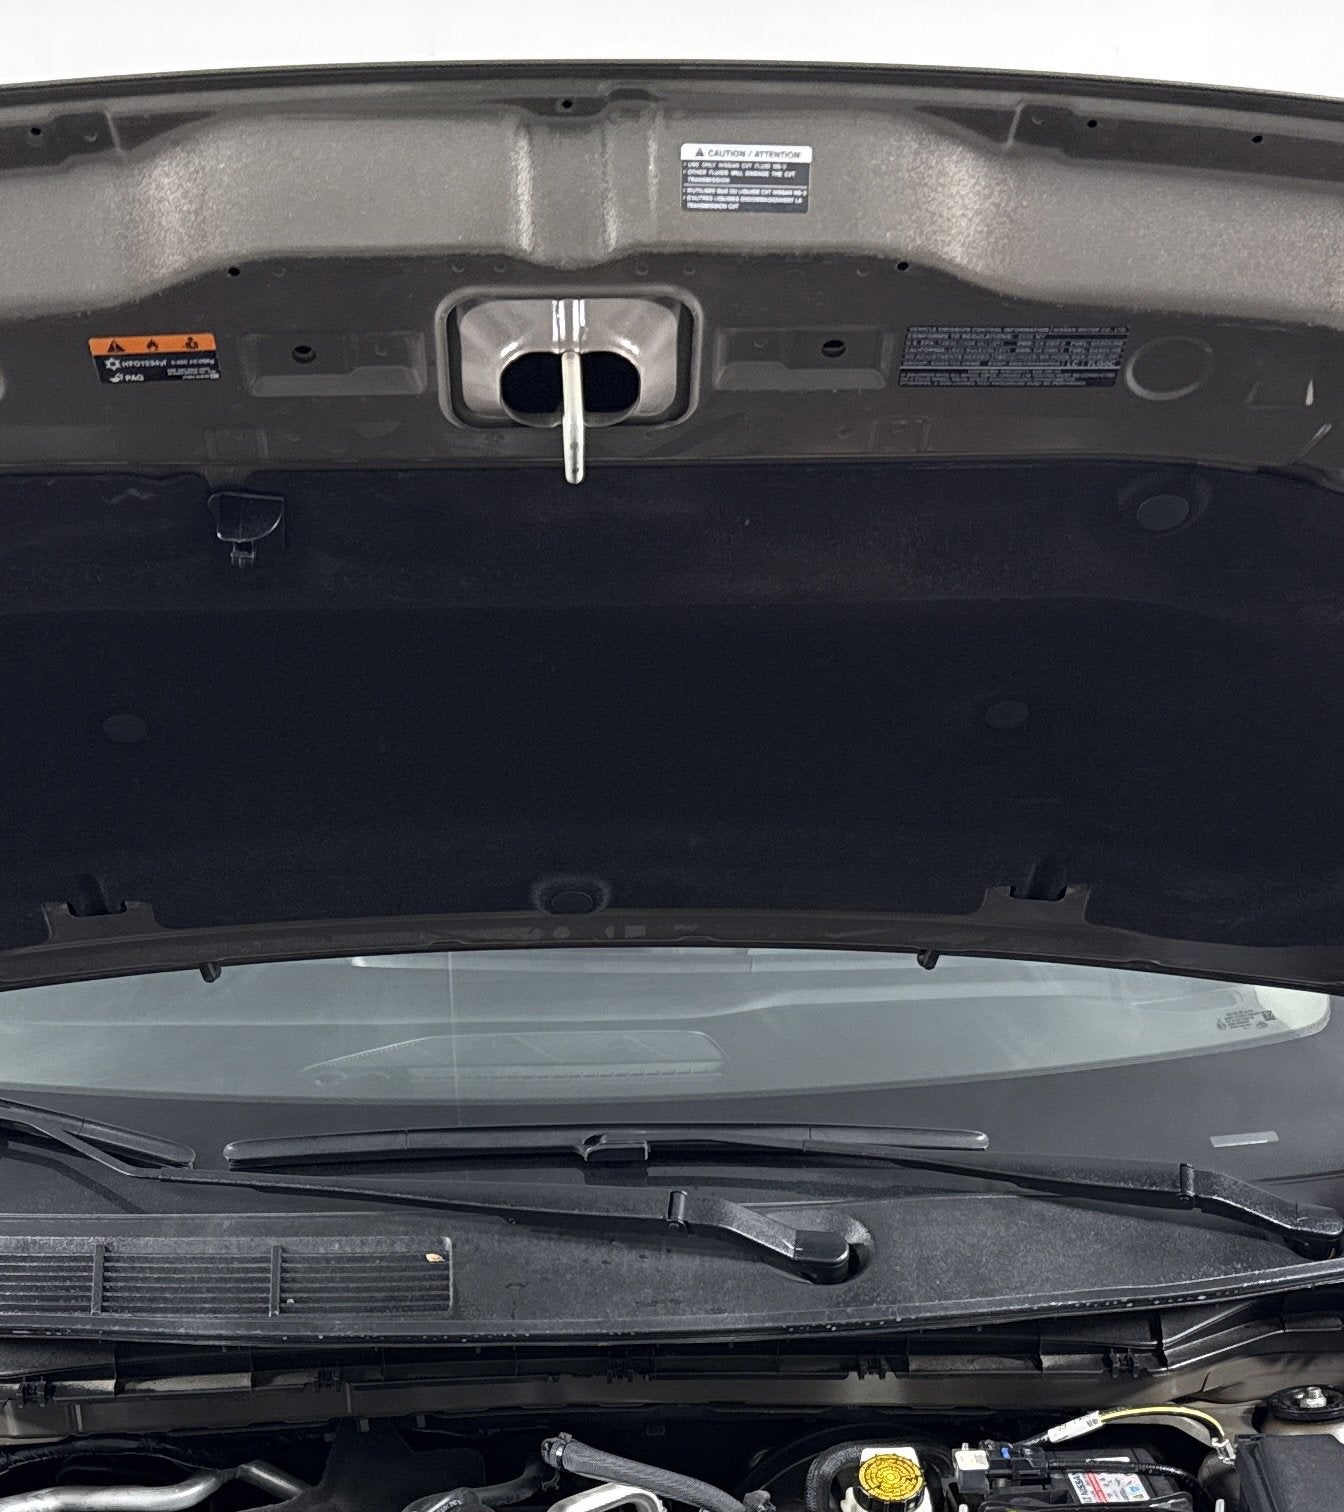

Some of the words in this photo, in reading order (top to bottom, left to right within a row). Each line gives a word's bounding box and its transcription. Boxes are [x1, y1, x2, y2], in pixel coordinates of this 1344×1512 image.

[708, 149, 746, 158] CAUTION
[754, 150, 802, 160] ATTENTION
[125, 374, 144, 382] PAG
